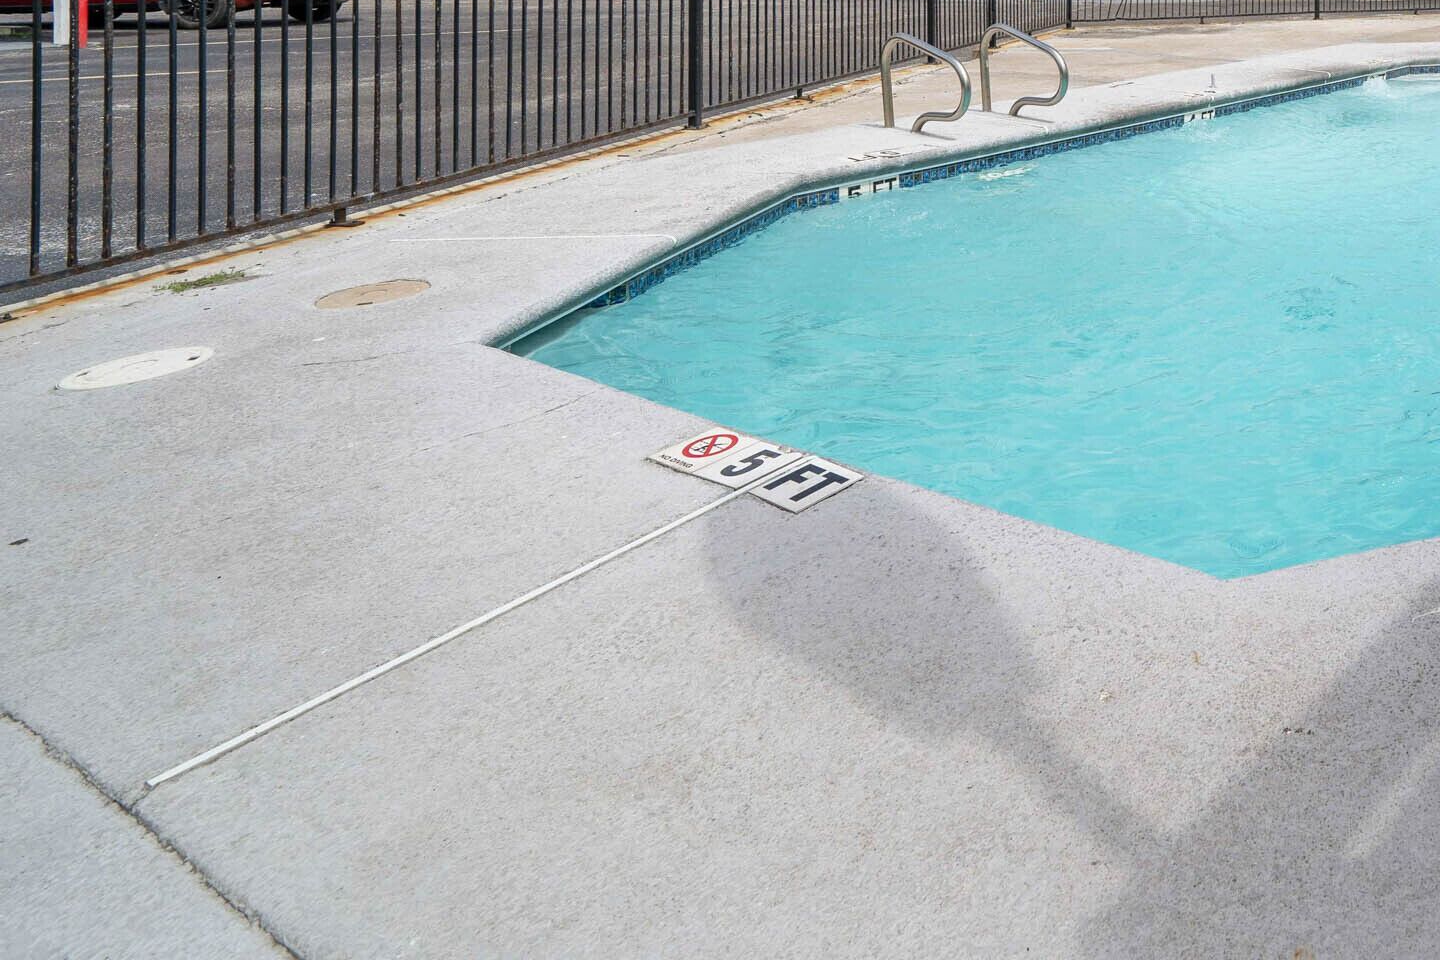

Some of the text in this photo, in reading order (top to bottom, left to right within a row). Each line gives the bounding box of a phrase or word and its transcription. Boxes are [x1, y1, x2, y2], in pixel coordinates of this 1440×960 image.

[848, 177, 897, 198] 5 FT
[720, 449, 851, 502] 5 FT
